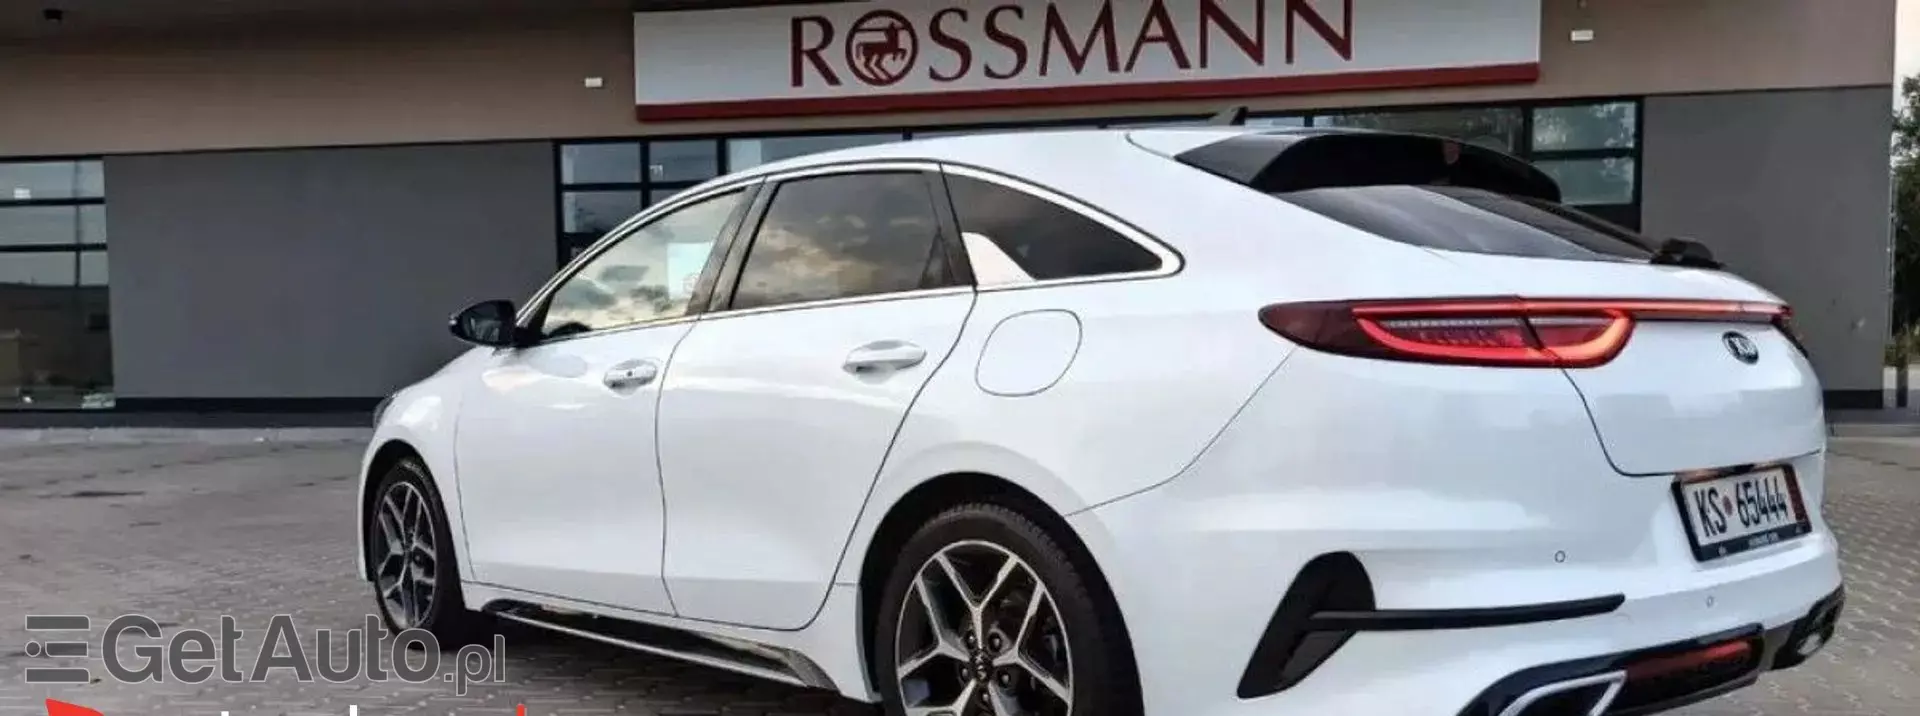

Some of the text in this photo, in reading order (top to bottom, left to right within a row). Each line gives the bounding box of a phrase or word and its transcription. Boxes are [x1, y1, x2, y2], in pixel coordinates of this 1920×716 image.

[791, 0, 1352, 87] ROSSMANN
[1694, 475, 1789, 538] KS 65444
